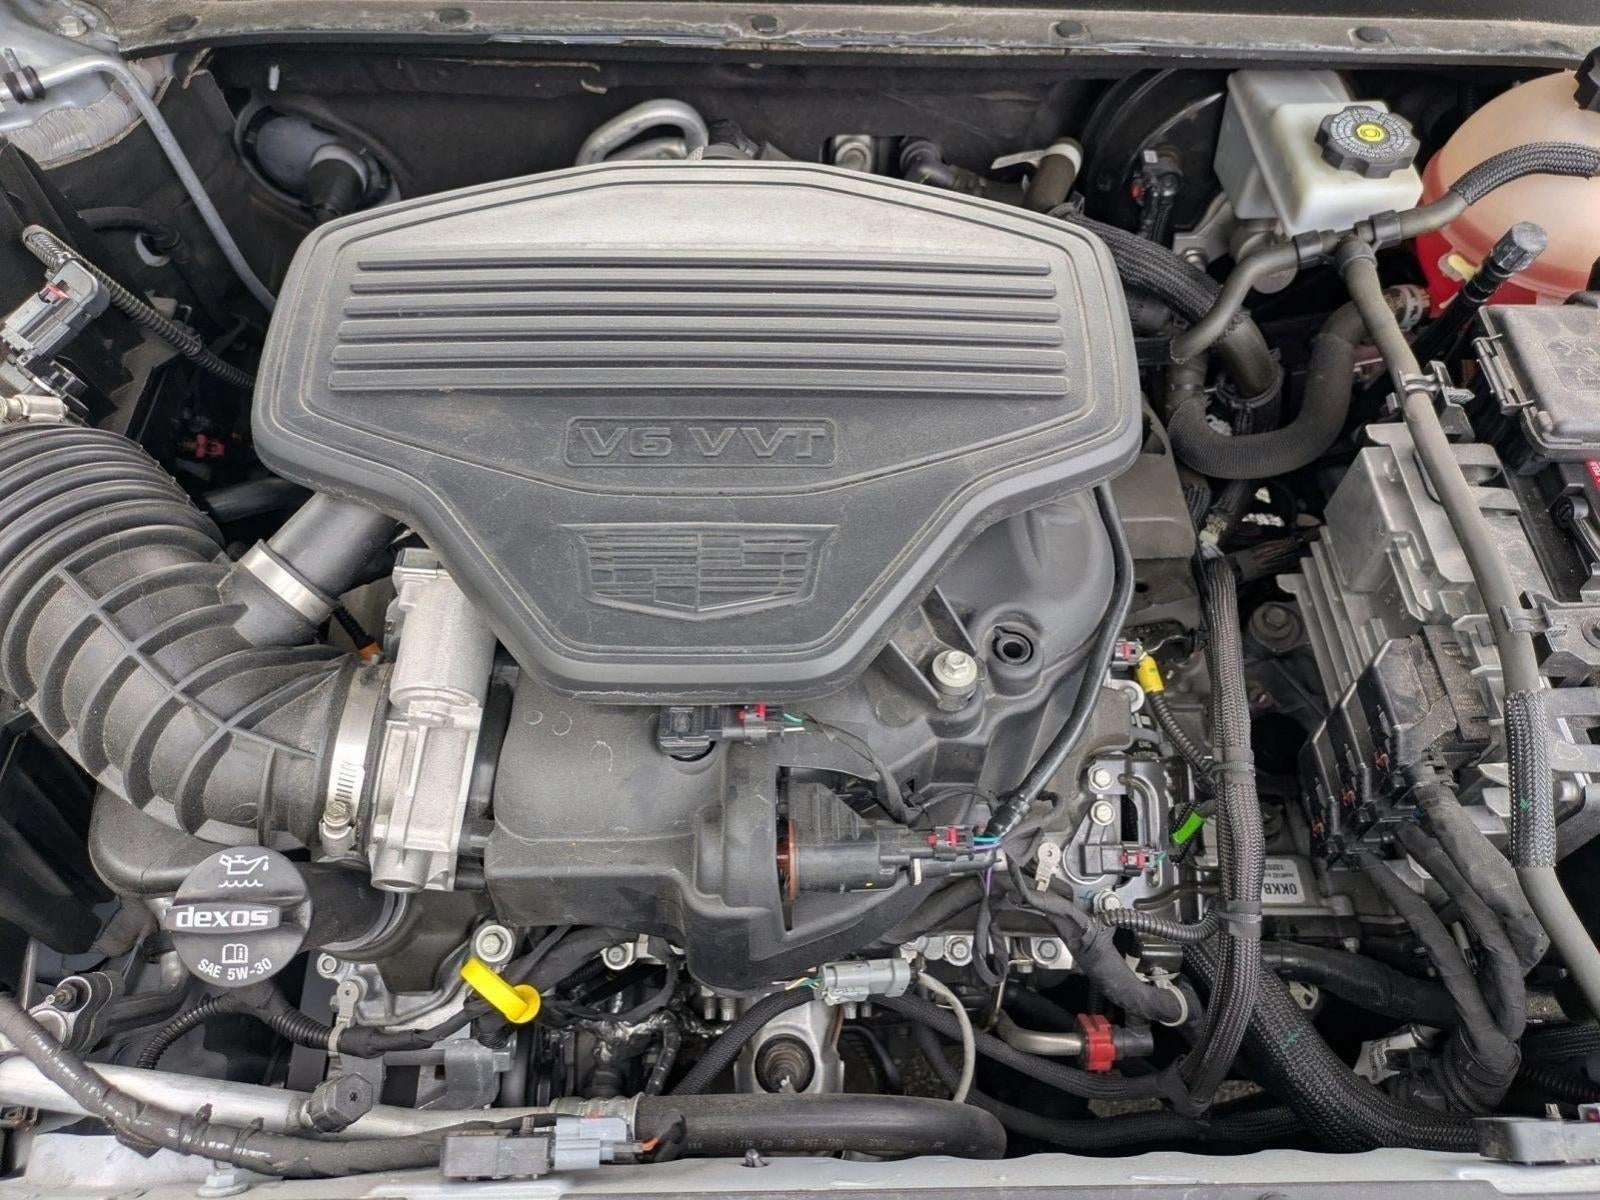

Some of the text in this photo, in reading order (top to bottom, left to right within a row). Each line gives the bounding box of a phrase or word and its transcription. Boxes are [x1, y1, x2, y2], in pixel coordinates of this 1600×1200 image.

[579, 427, 826, 458] V6 VVT
[176, 906, 272, 928] dexos
[198, 957, 272, 981] SAE 5W-30
